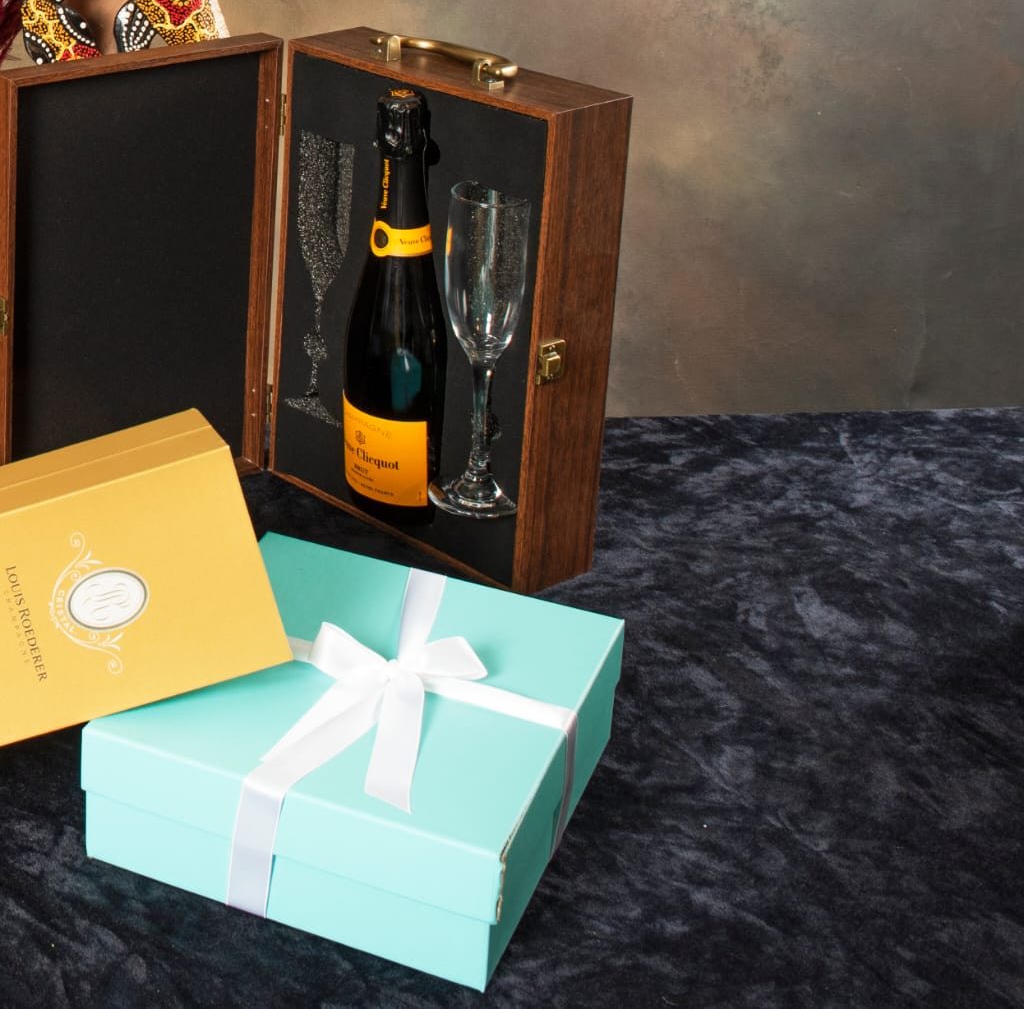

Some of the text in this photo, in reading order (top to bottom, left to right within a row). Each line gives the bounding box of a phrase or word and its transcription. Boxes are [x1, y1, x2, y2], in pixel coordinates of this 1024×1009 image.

[356, 447, 400, 471] Clicquot
[5, 565, 48, 682] LOUIS ROEDERER
